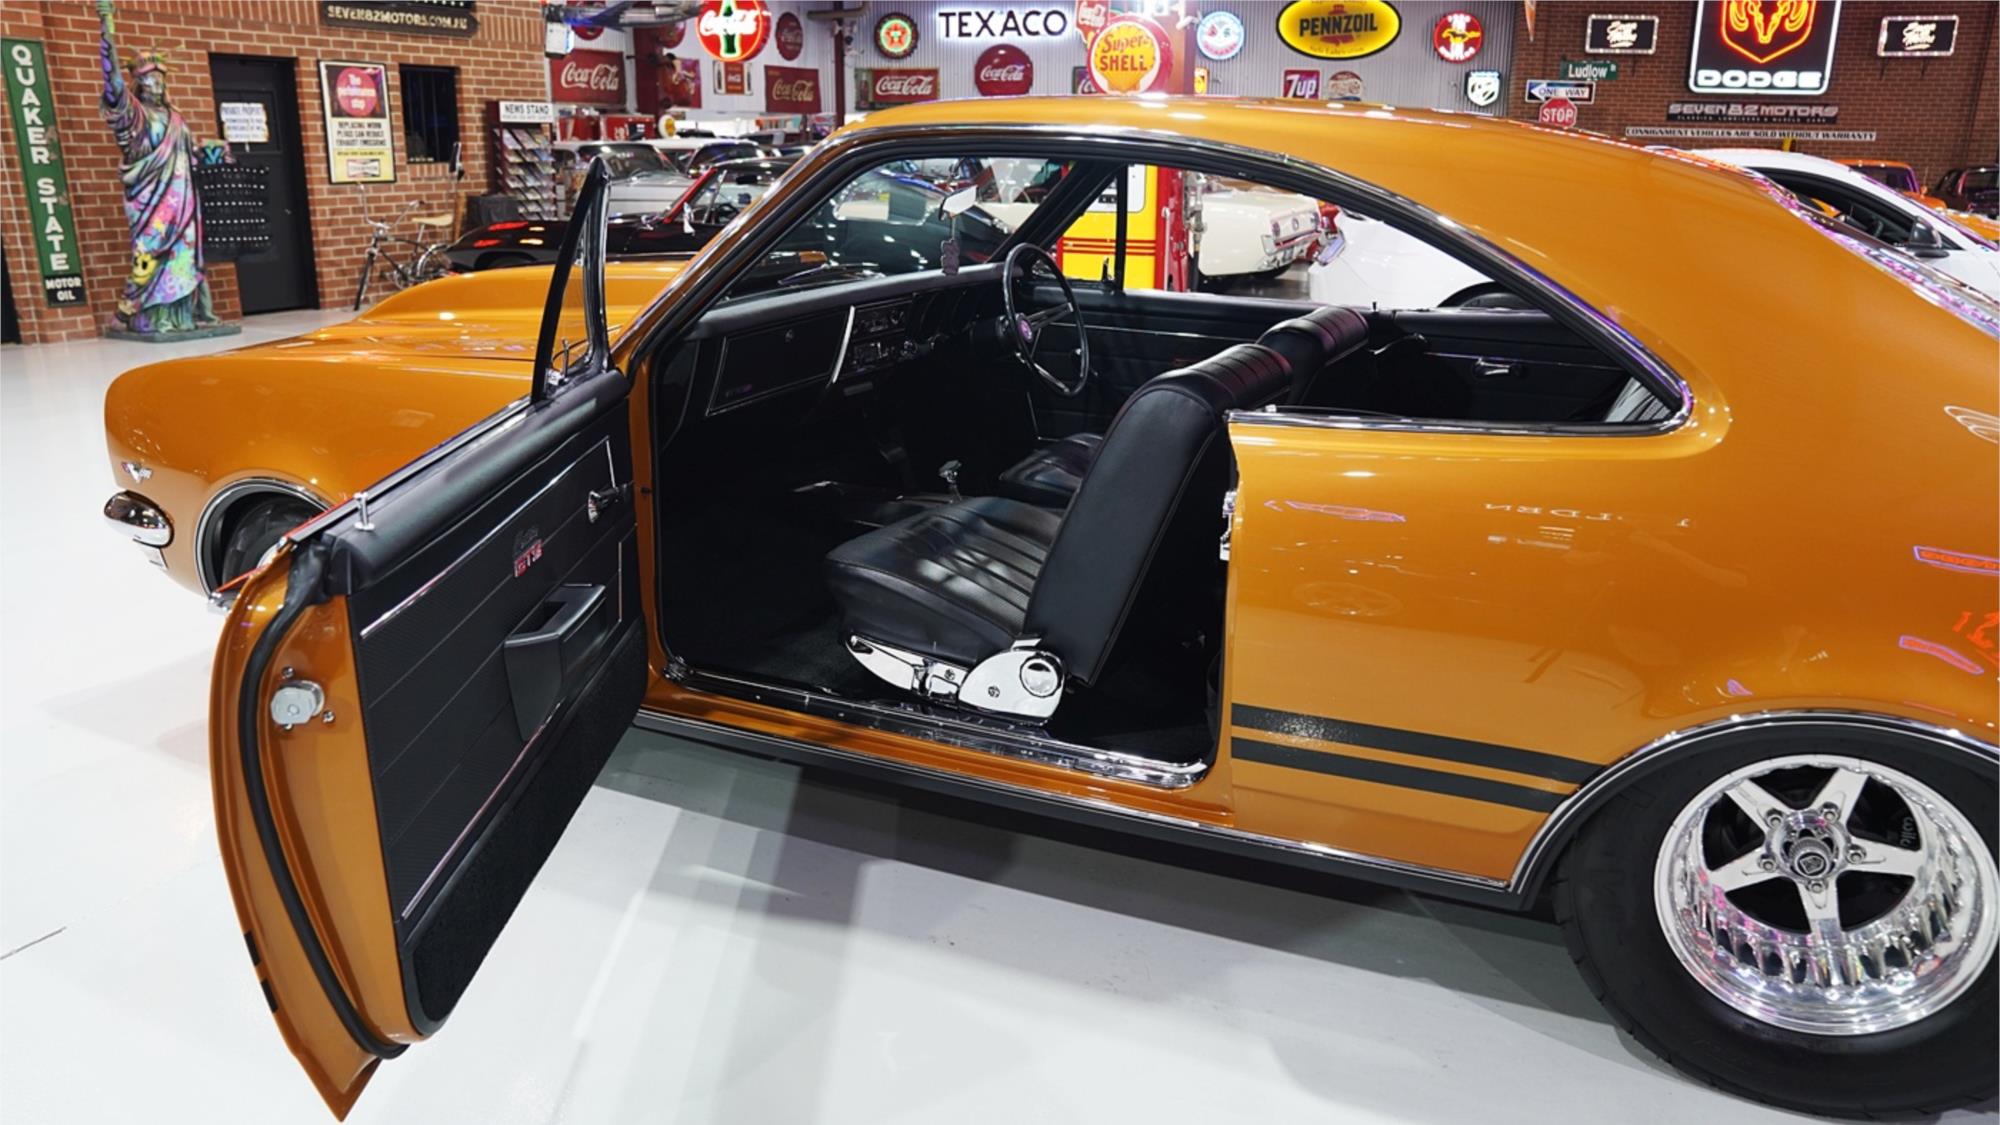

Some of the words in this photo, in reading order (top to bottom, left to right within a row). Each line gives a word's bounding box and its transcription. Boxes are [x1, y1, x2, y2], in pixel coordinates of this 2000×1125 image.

[938, 9, 1067, 38] TEXACO
[1299, 12, 1378, 37] PENNZOIL
[1100, 55, 1147, 72] SHELL
[1568, 63, 1608, 79] Ludlow
[1697, 69, 1822, 88] DODGE
[1565, 88, 1586, 97] WAY
[11, 44, 51, 164] QUAKER
[505, 104, 524, 114] NEWS
[526, 104, 549, 115] STAND
[1542, 108, 1574, 122] STOP
[1626, 127, 1688, 136] CONSIGNMENT
[1690, 128, 1732, 137] VEHICLES
[1735, 129, 1751, 137] ARE
[1753, 130, 1776, 138] SOLD
[1822, 131, 1874, 139] WARRANTY
[37, 178, 70, 271] STATE
[45, 277, 82, 290] MOTOR
[56, 290, 76, 301] OIL
